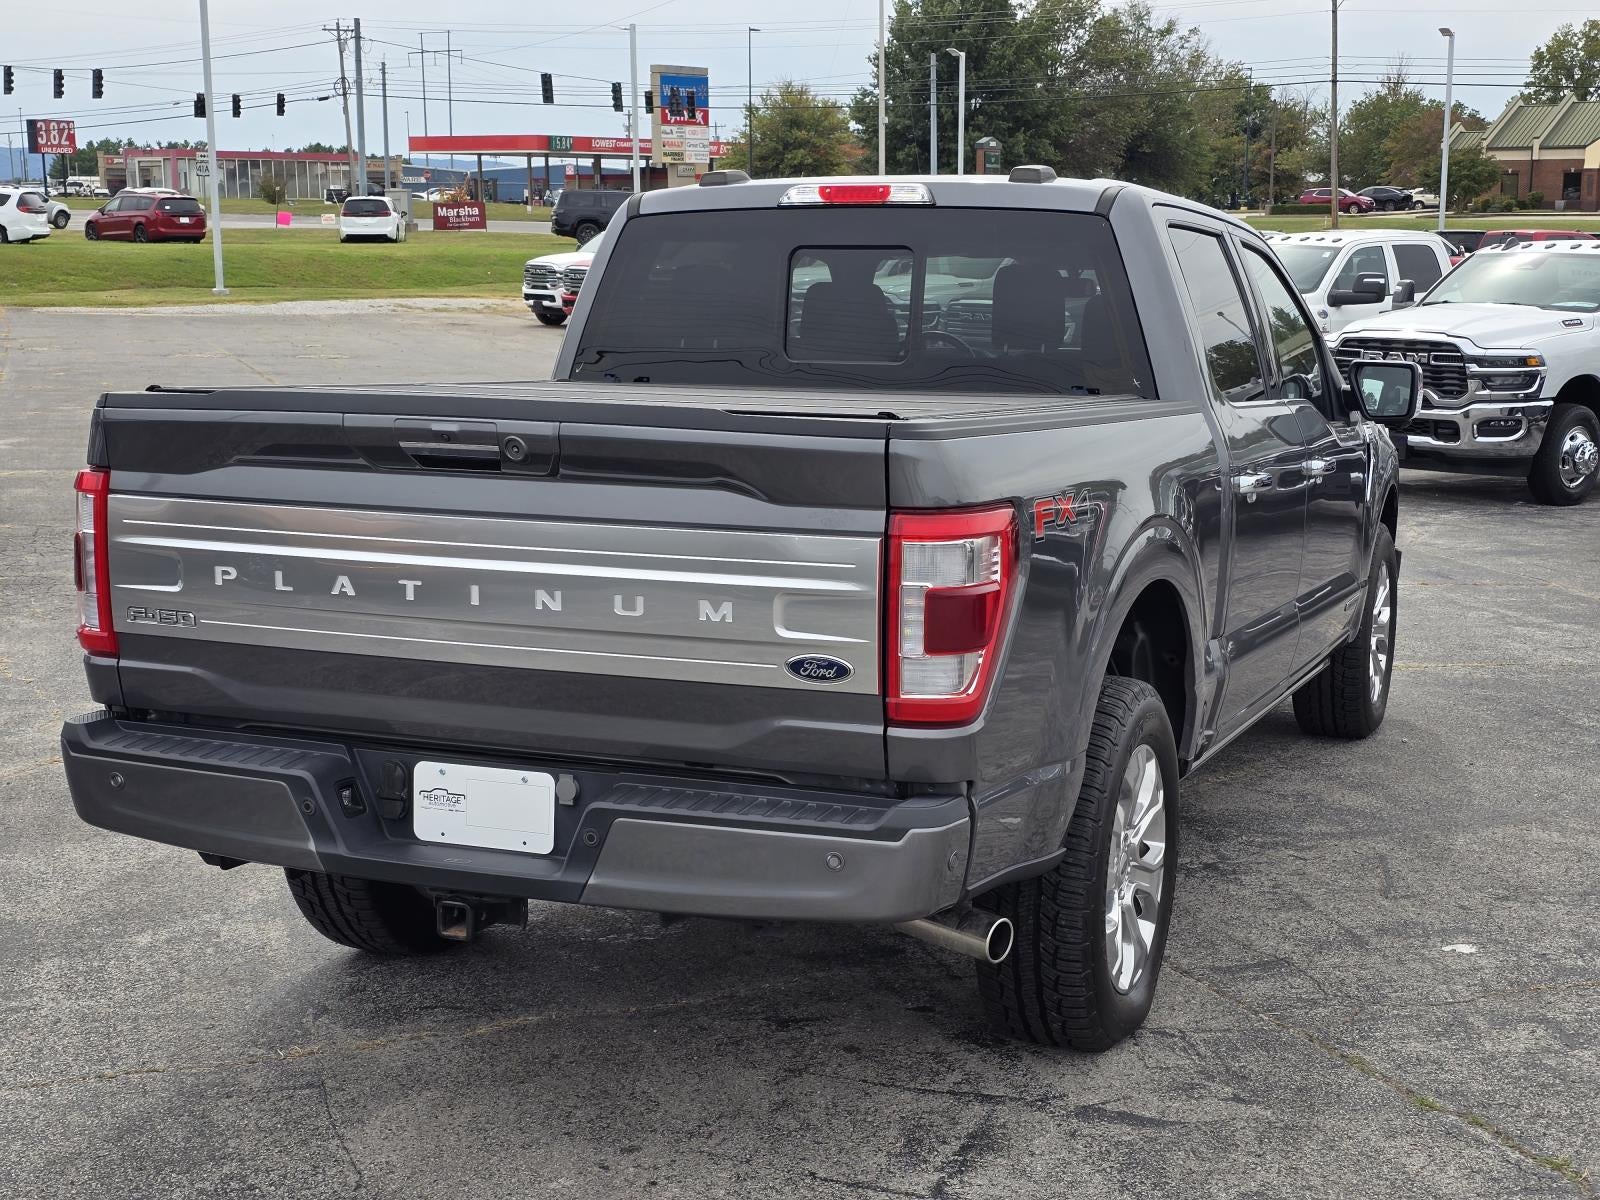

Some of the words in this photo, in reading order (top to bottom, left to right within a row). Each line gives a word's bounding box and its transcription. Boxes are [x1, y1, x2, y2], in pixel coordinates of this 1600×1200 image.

[41, 146, 73, 154] UNLEADED
[591, 139, 617, 149] LOWEST
[437, 205, 479, 217] Marsha
[1033, 487, 1096, 544] FX4
[212, 564, 735, 624] PLATINUM
[126, 605, 198, 629] F-150
[799, 659, 838, 678] Ford
[422, 793, 463, 805] HERITAGE
